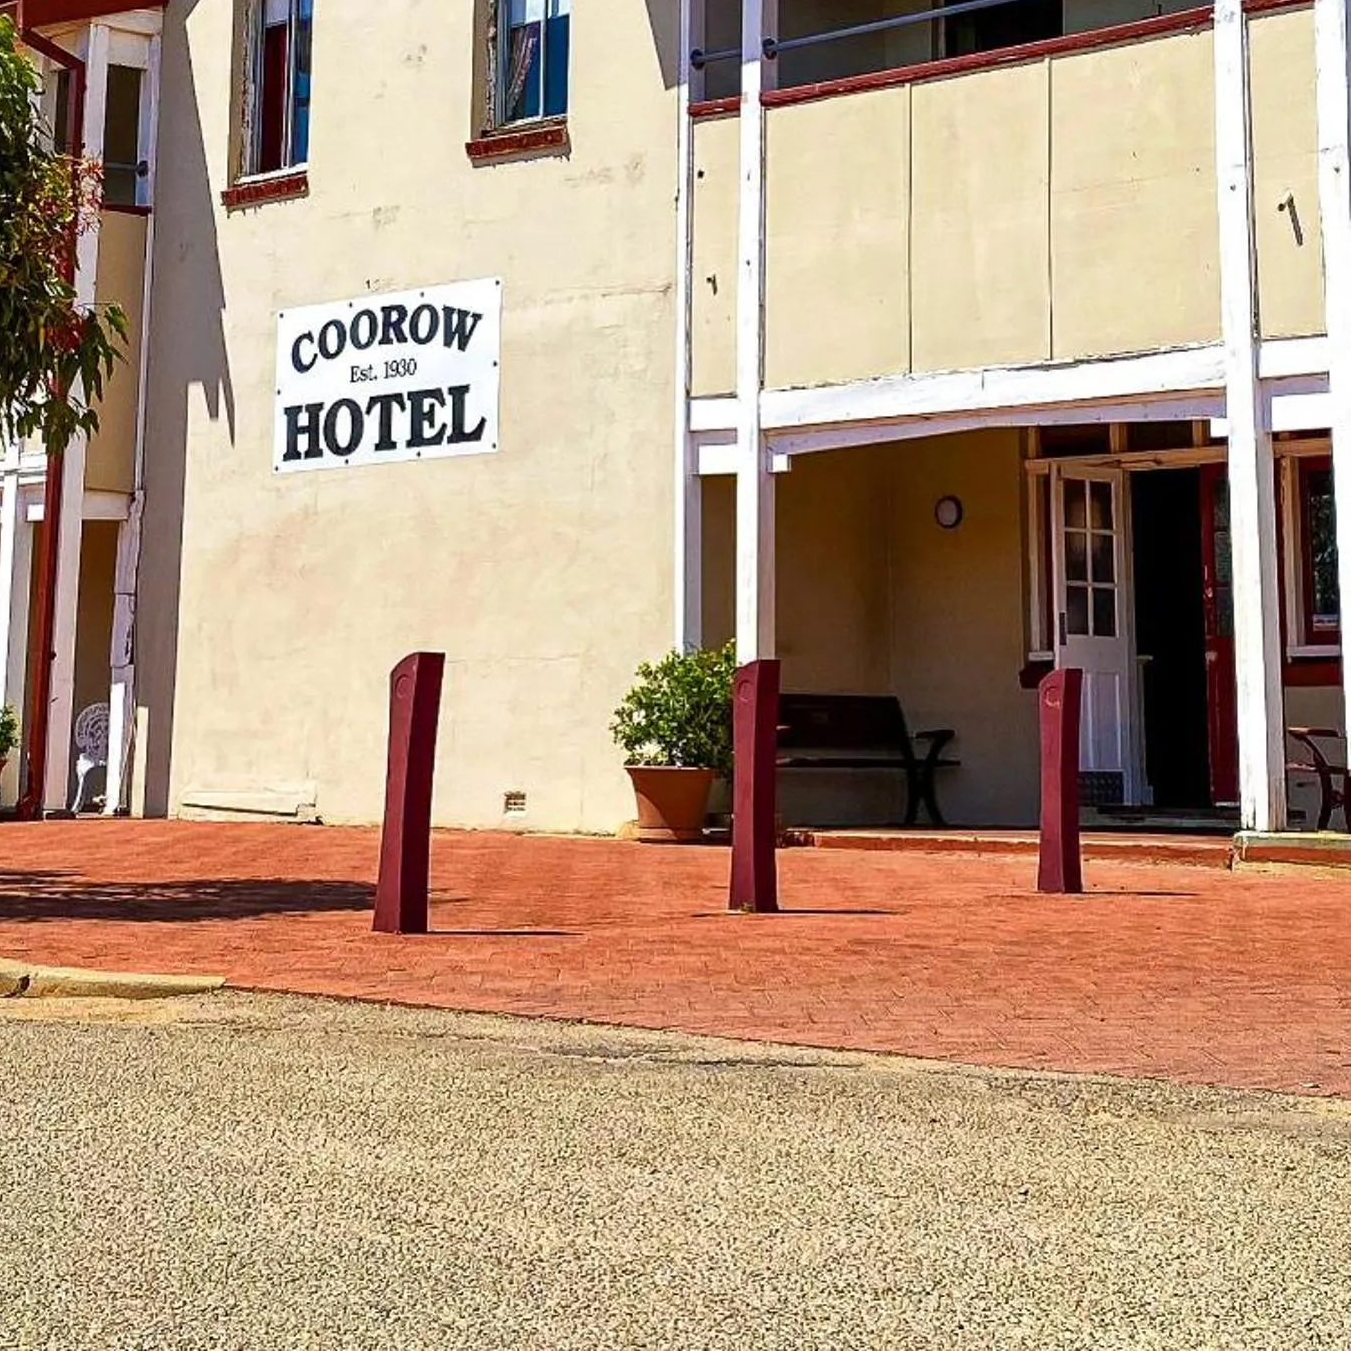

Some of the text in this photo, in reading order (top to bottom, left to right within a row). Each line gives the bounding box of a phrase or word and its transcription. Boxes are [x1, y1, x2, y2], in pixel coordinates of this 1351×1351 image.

[291, 303, 483, 373] COOROW
[349, 357, 417, 383] Est. 1930
[282, 383, 487, 462] HOTEL
